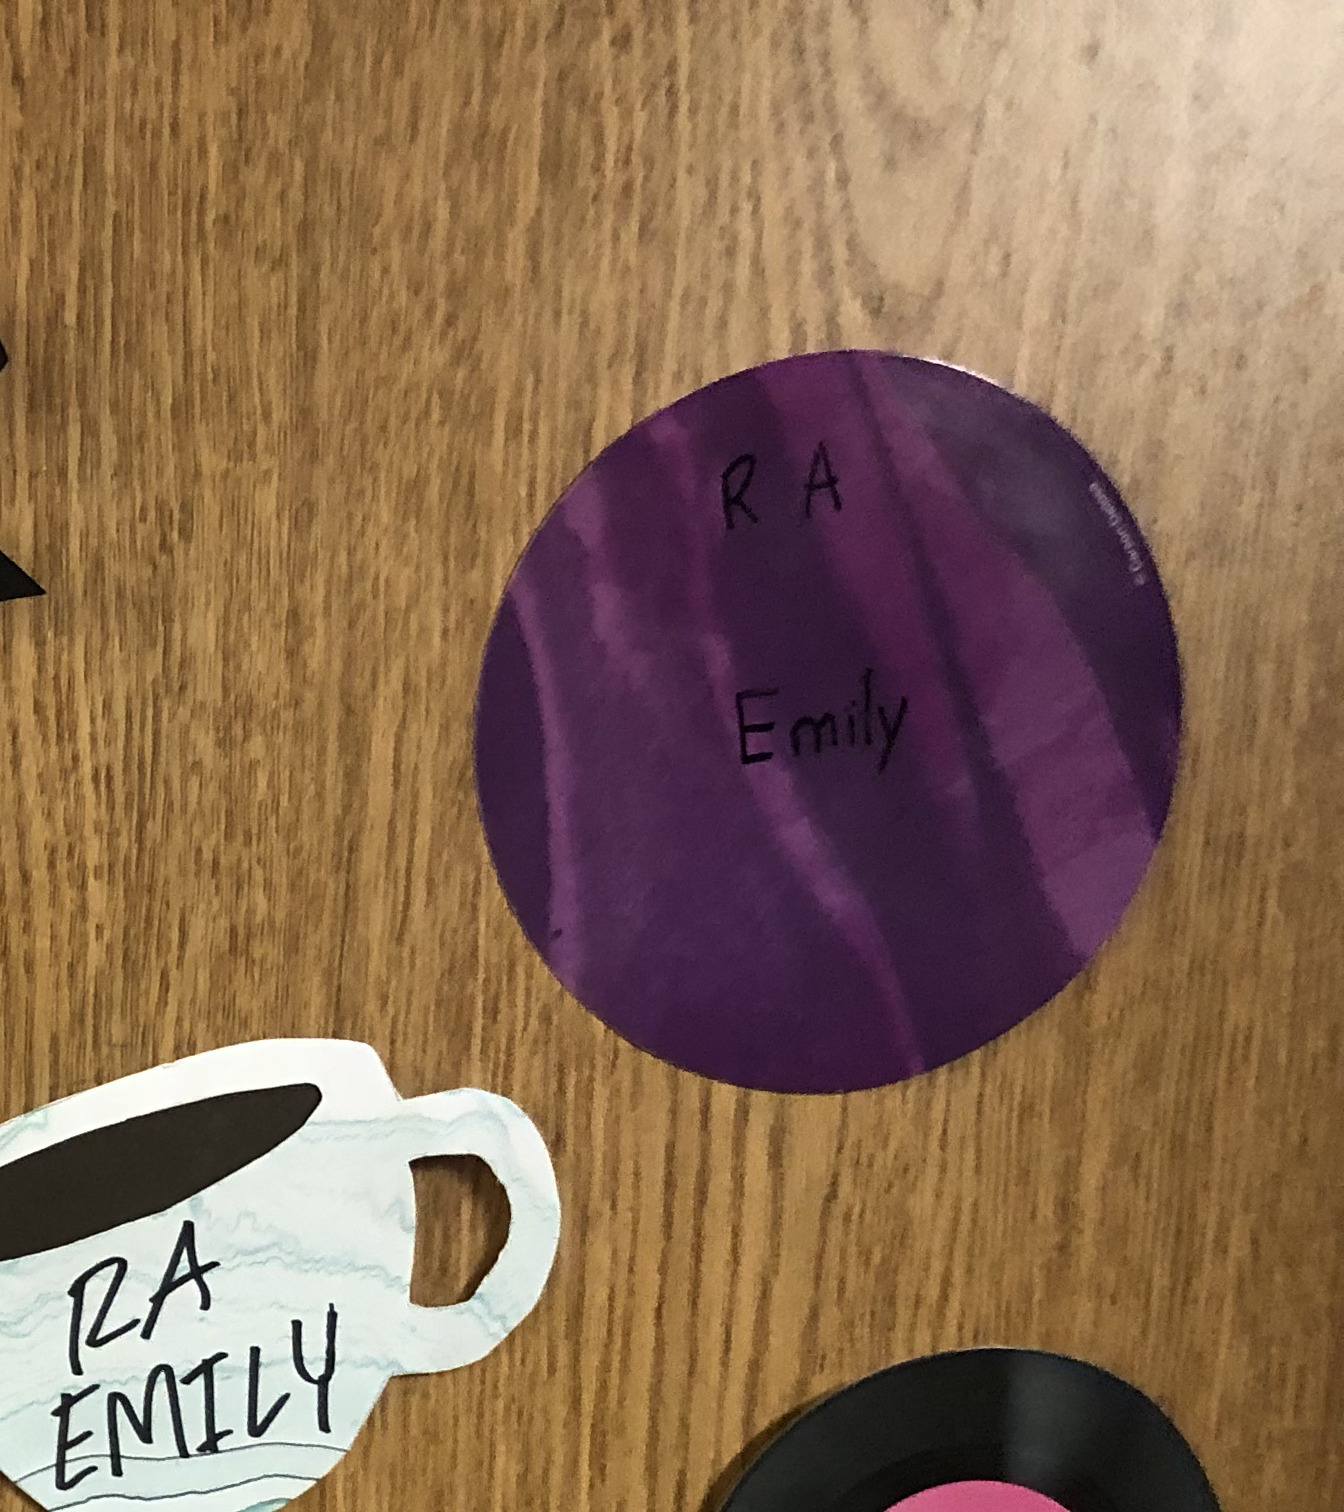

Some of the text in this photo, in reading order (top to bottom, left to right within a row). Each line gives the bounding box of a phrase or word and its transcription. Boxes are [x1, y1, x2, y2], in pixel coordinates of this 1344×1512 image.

[734, 668, 909, 775] Emily
[67, 1220, 221, 1376] RA
[50, 1303, 339, 1490] EMILY
